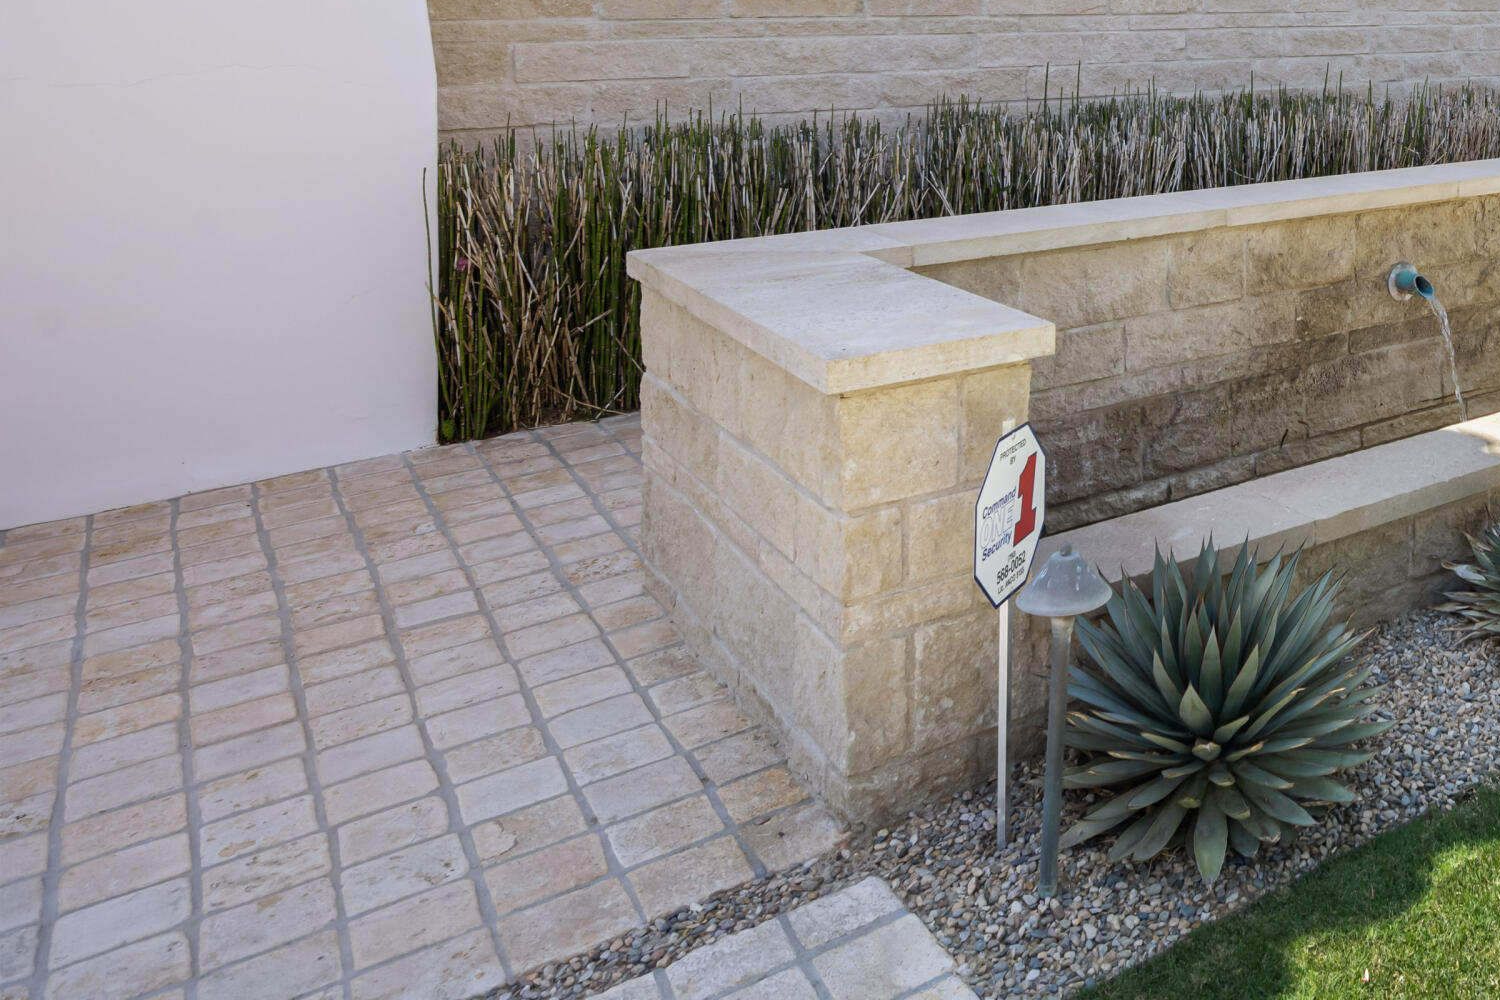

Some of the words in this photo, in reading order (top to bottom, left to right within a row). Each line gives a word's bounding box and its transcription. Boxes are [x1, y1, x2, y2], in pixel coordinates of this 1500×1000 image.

[1000, 438, 1027, 460] PROTECTED
[982, 486, 1017, 520] Command
[1014, 451, 1037, 548] 1
[980, 504, 1015, 549] ONE
[981, 530, 1013, 562] Security
